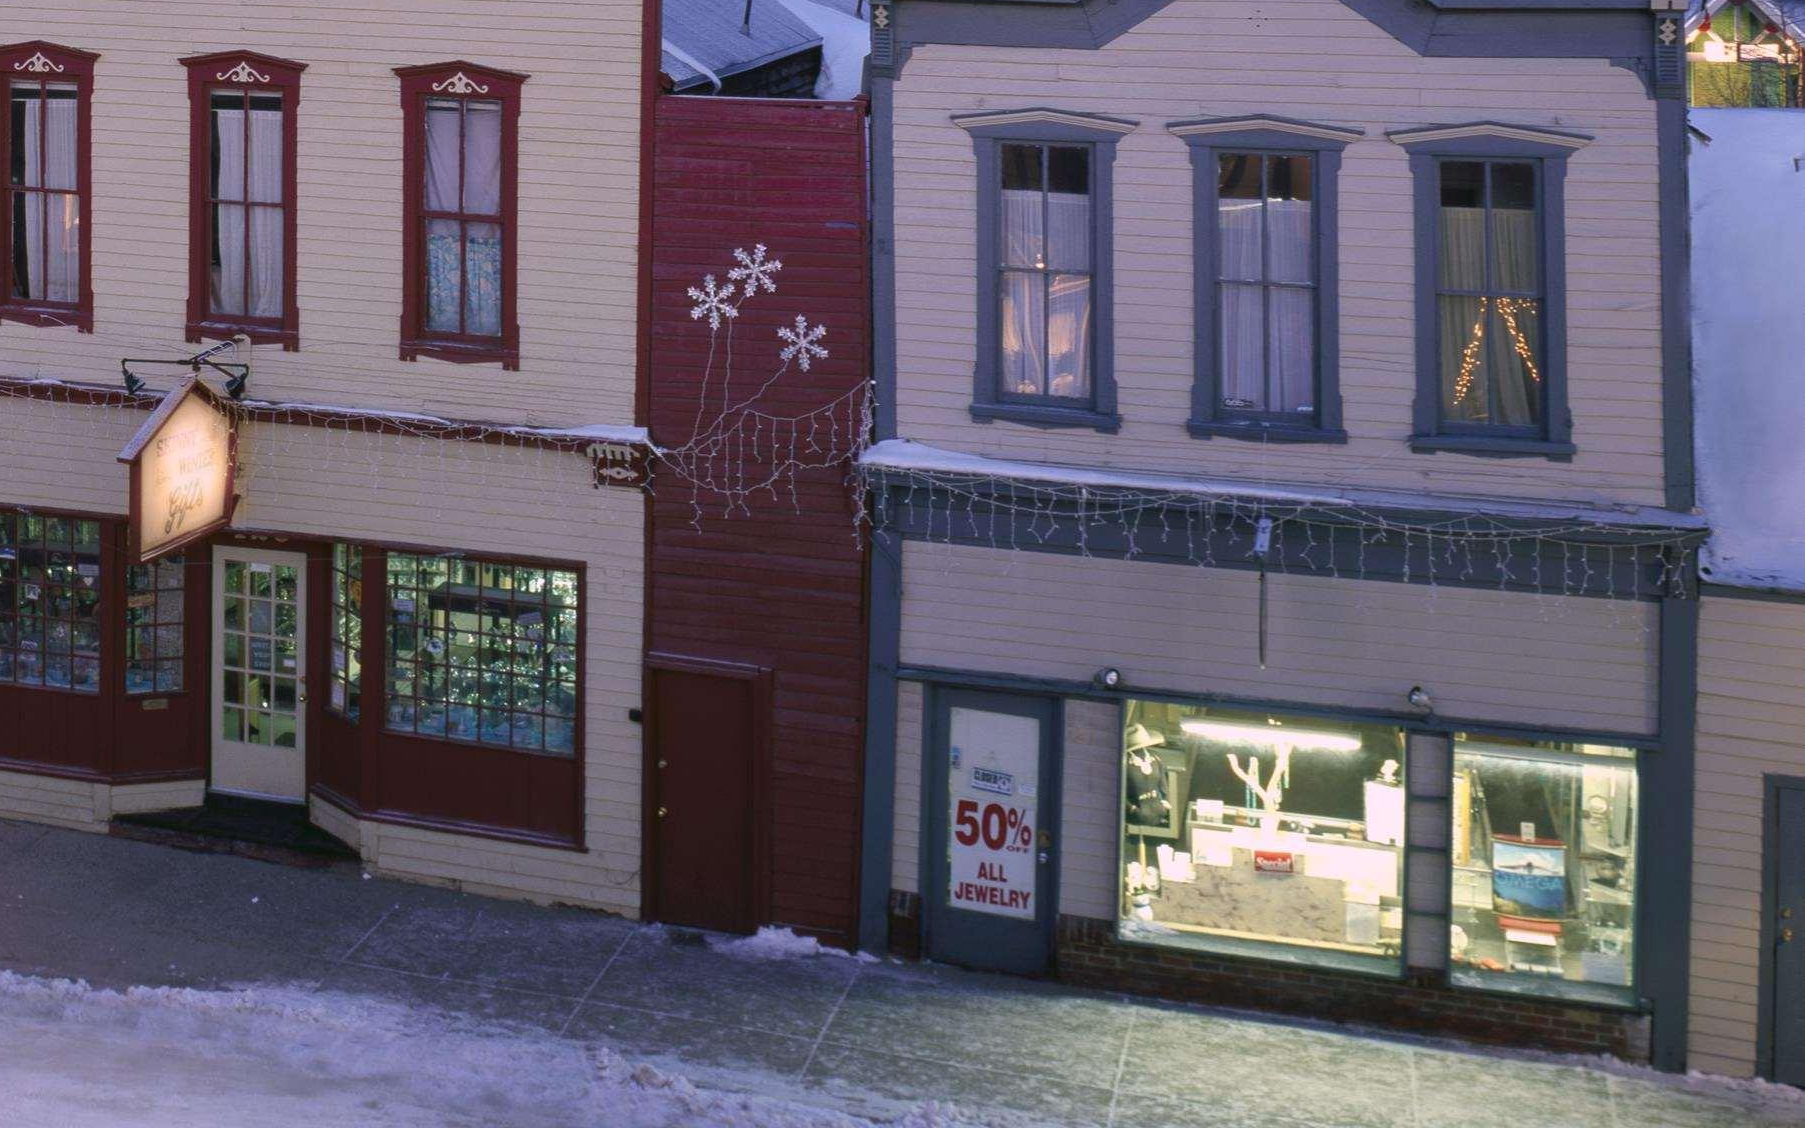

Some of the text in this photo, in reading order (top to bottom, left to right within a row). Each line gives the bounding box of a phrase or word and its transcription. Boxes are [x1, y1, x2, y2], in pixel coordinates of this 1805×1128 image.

[955, 800, 1031, 851] 50%
[1006, 845, 1030, 853] OFF
[977, 862, 1008, 883] ALL
[1495, 873, 1563, 890] OMEGA
[954, 882, 1031, 909] JEWELRY
